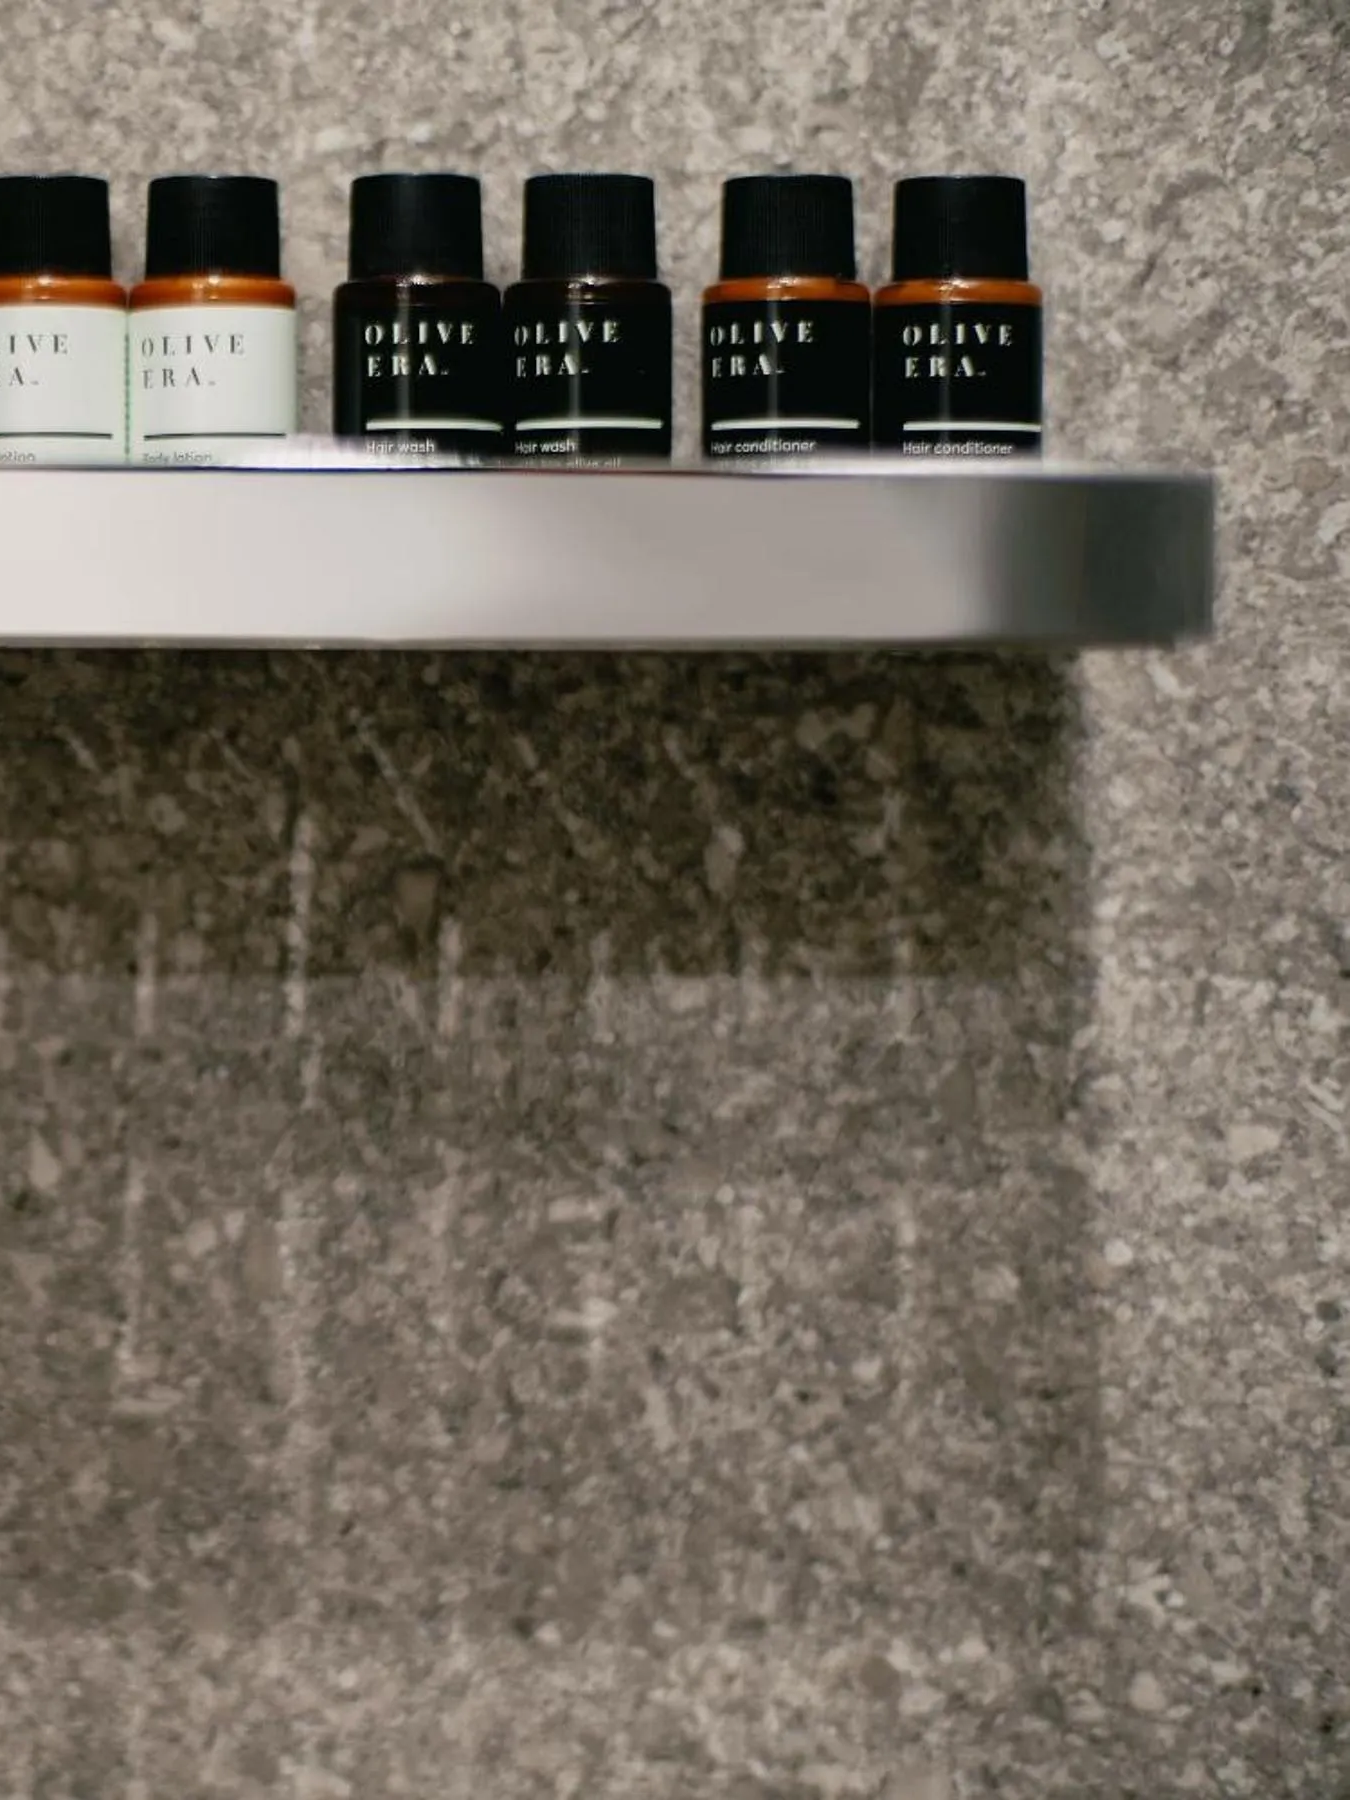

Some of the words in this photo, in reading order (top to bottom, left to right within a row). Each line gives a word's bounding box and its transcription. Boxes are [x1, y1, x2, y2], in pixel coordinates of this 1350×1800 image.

[364, 320, 475, 346] OLIVE
[514, 320, 622, 346] OLIVE
[710, 320, 815, 346] OLIVE
[903, 322, 1013, 346] OLIVE
[141, 334, 245, 358] OLIVE
[366, 440, 394, 454] Hair
[397, 438, 435, 453] wash
[514, 441, 537, 454] Hair
[539, 438, 576, 453] wash
[710, 441, 732, 454] Hair
[734, 438, 817, 453] conditioner
[903, 440, 931, 454] Hair
[933, 439, 1013, 455] conditioner
